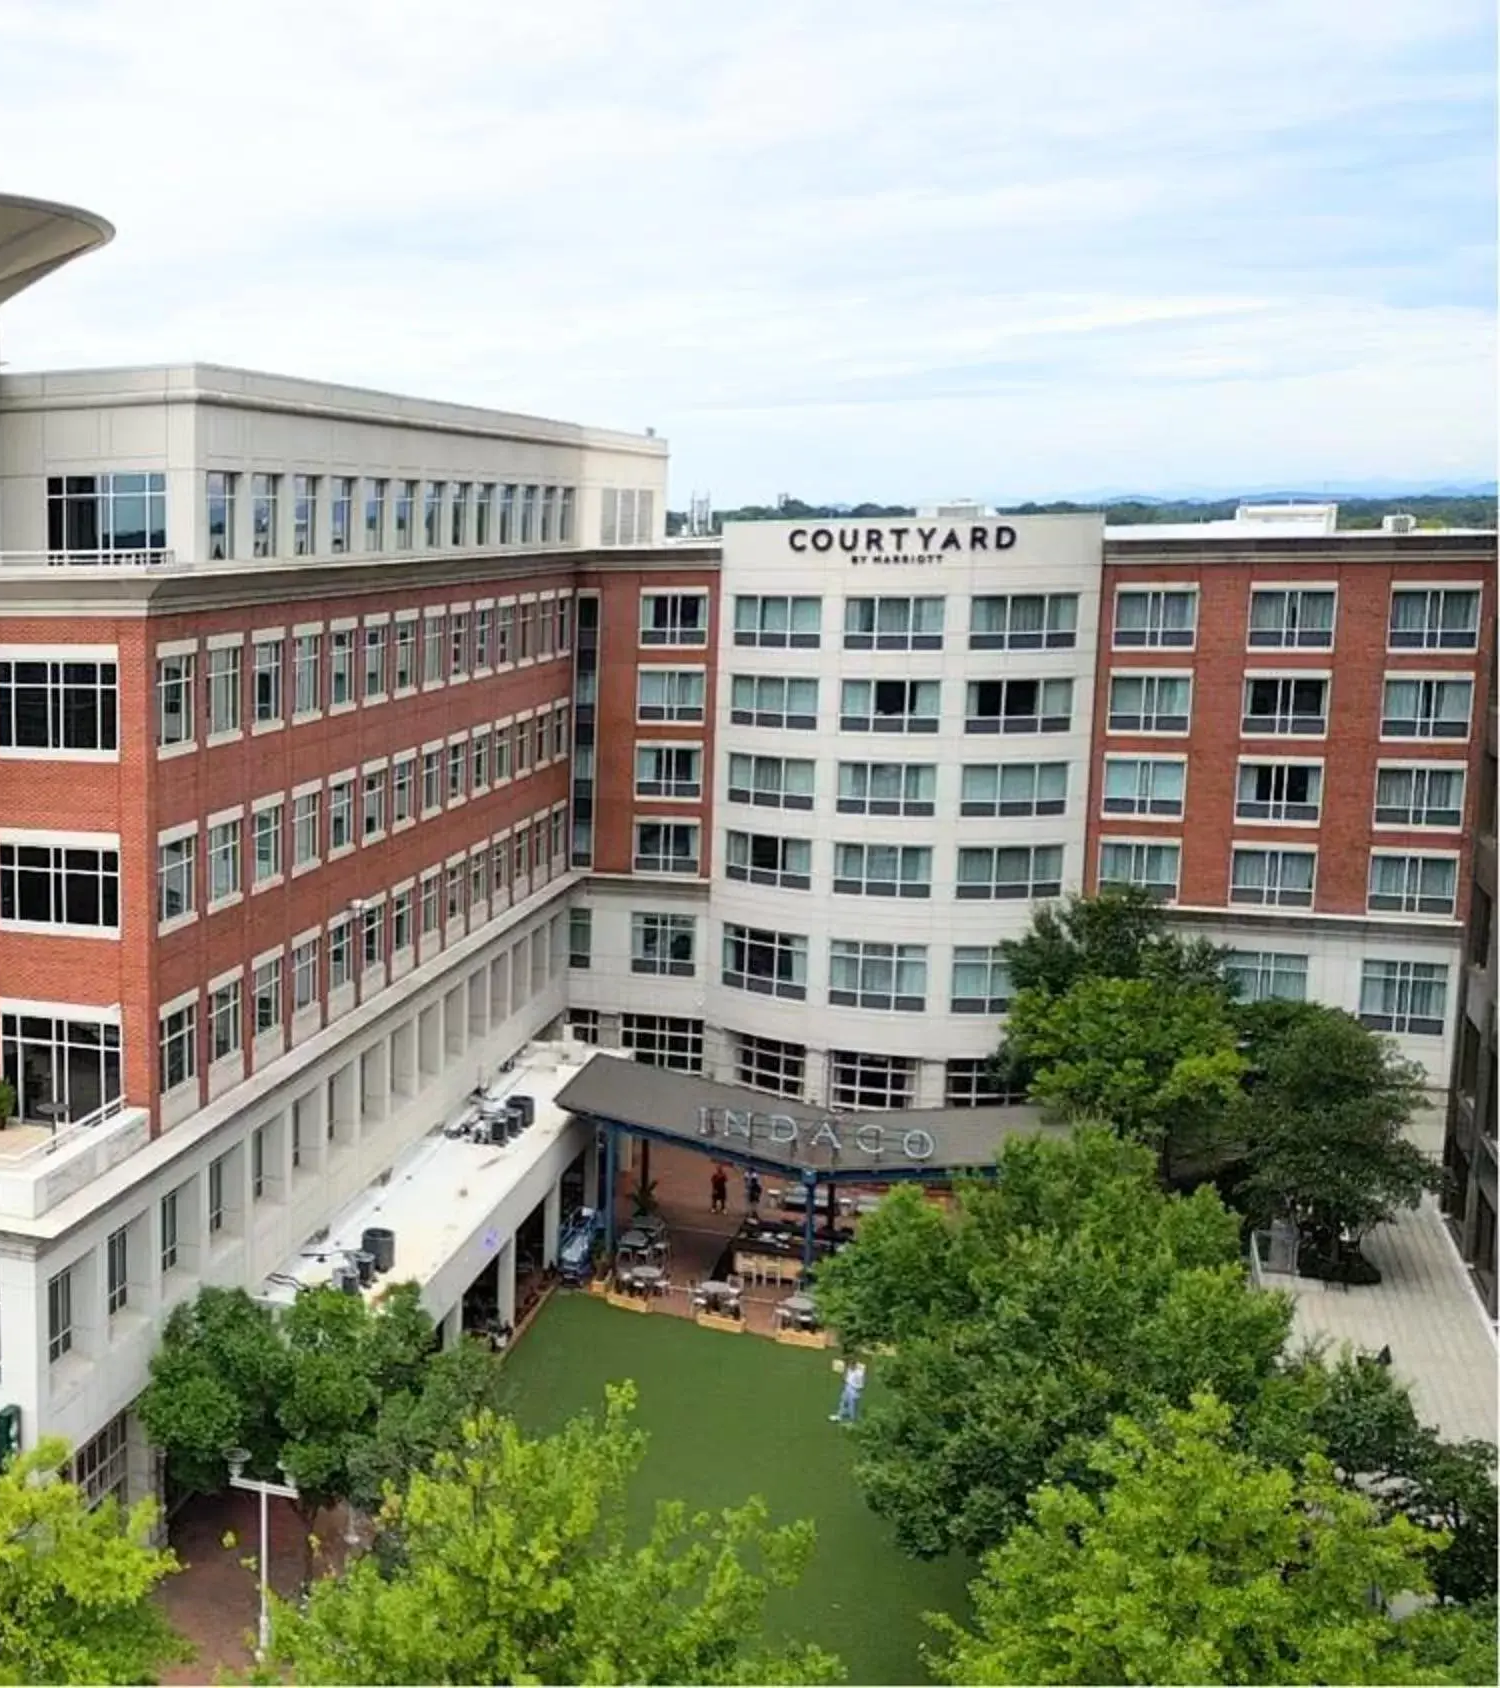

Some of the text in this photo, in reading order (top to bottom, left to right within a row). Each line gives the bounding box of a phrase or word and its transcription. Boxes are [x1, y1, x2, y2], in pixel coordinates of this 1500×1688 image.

[789, 525, 1018, 552] COURTYARD
[851, 554, 942, 565] BY MARRIOTT
[698, 1107, 935, 1158] INDACO
